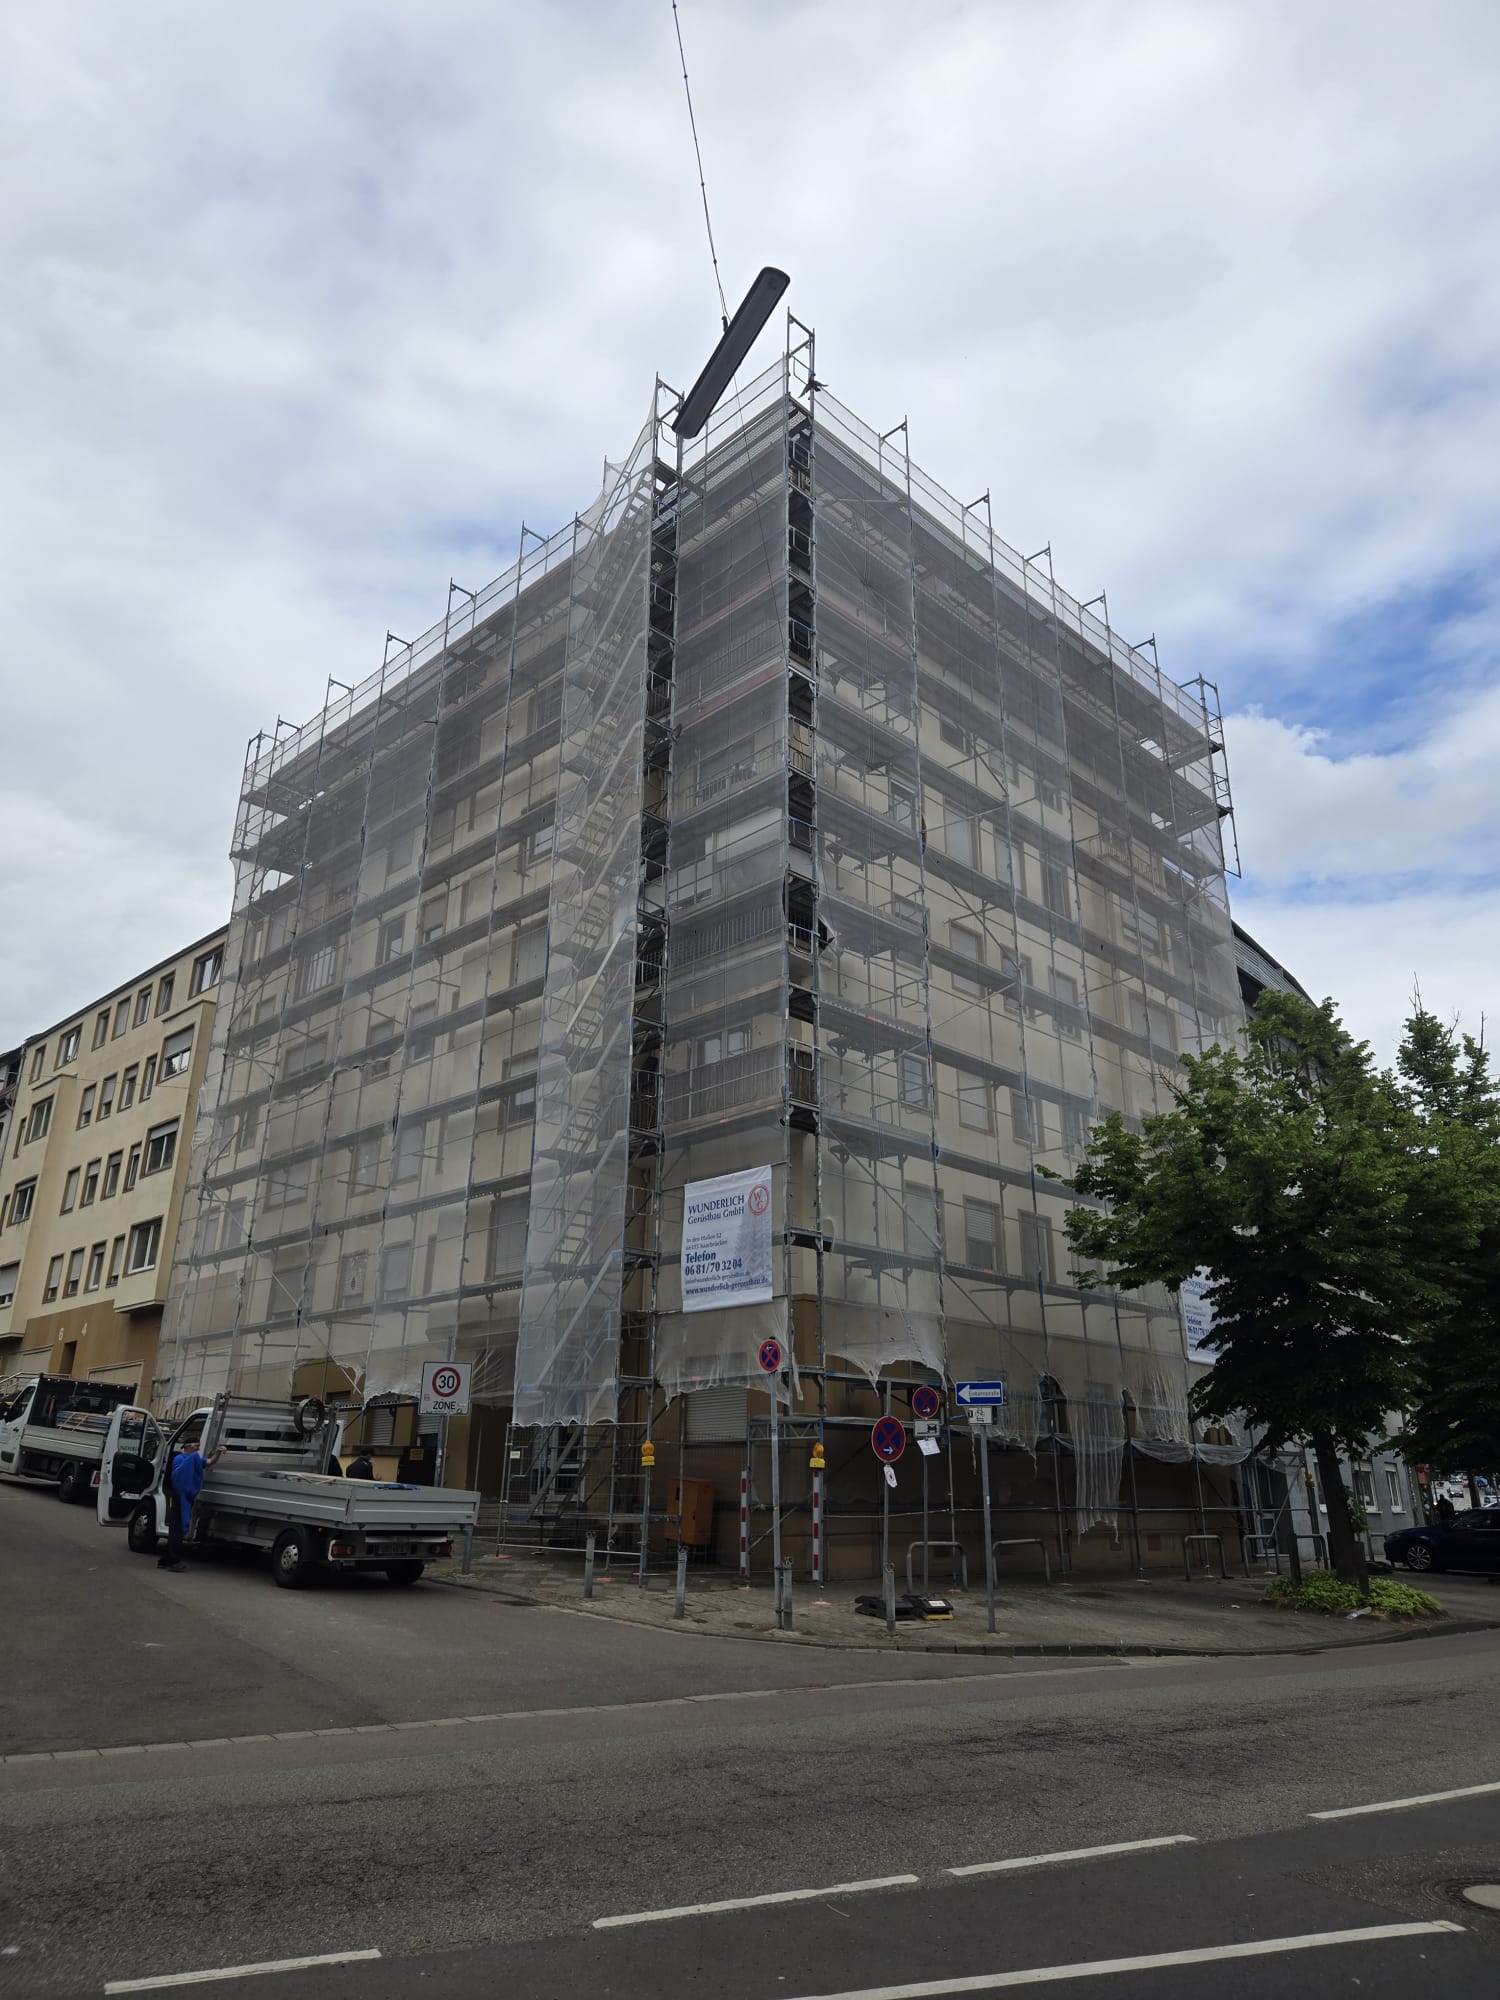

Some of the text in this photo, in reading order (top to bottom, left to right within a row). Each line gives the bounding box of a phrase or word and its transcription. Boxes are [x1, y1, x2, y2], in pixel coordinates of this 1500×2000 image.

[688, 1195, 745, 1214] WUNDERLICH
[687, 1206, 744, 1225] Gerüstbau GmbH
[685, 1250, 717, 1264] Telefon
[59, 1328, 64, 1341] 6
[81, 1322, 87, 1336] 4
[438, 1375, 455, 1389] 30
[433, 1401, 456, 1410] ZONE
